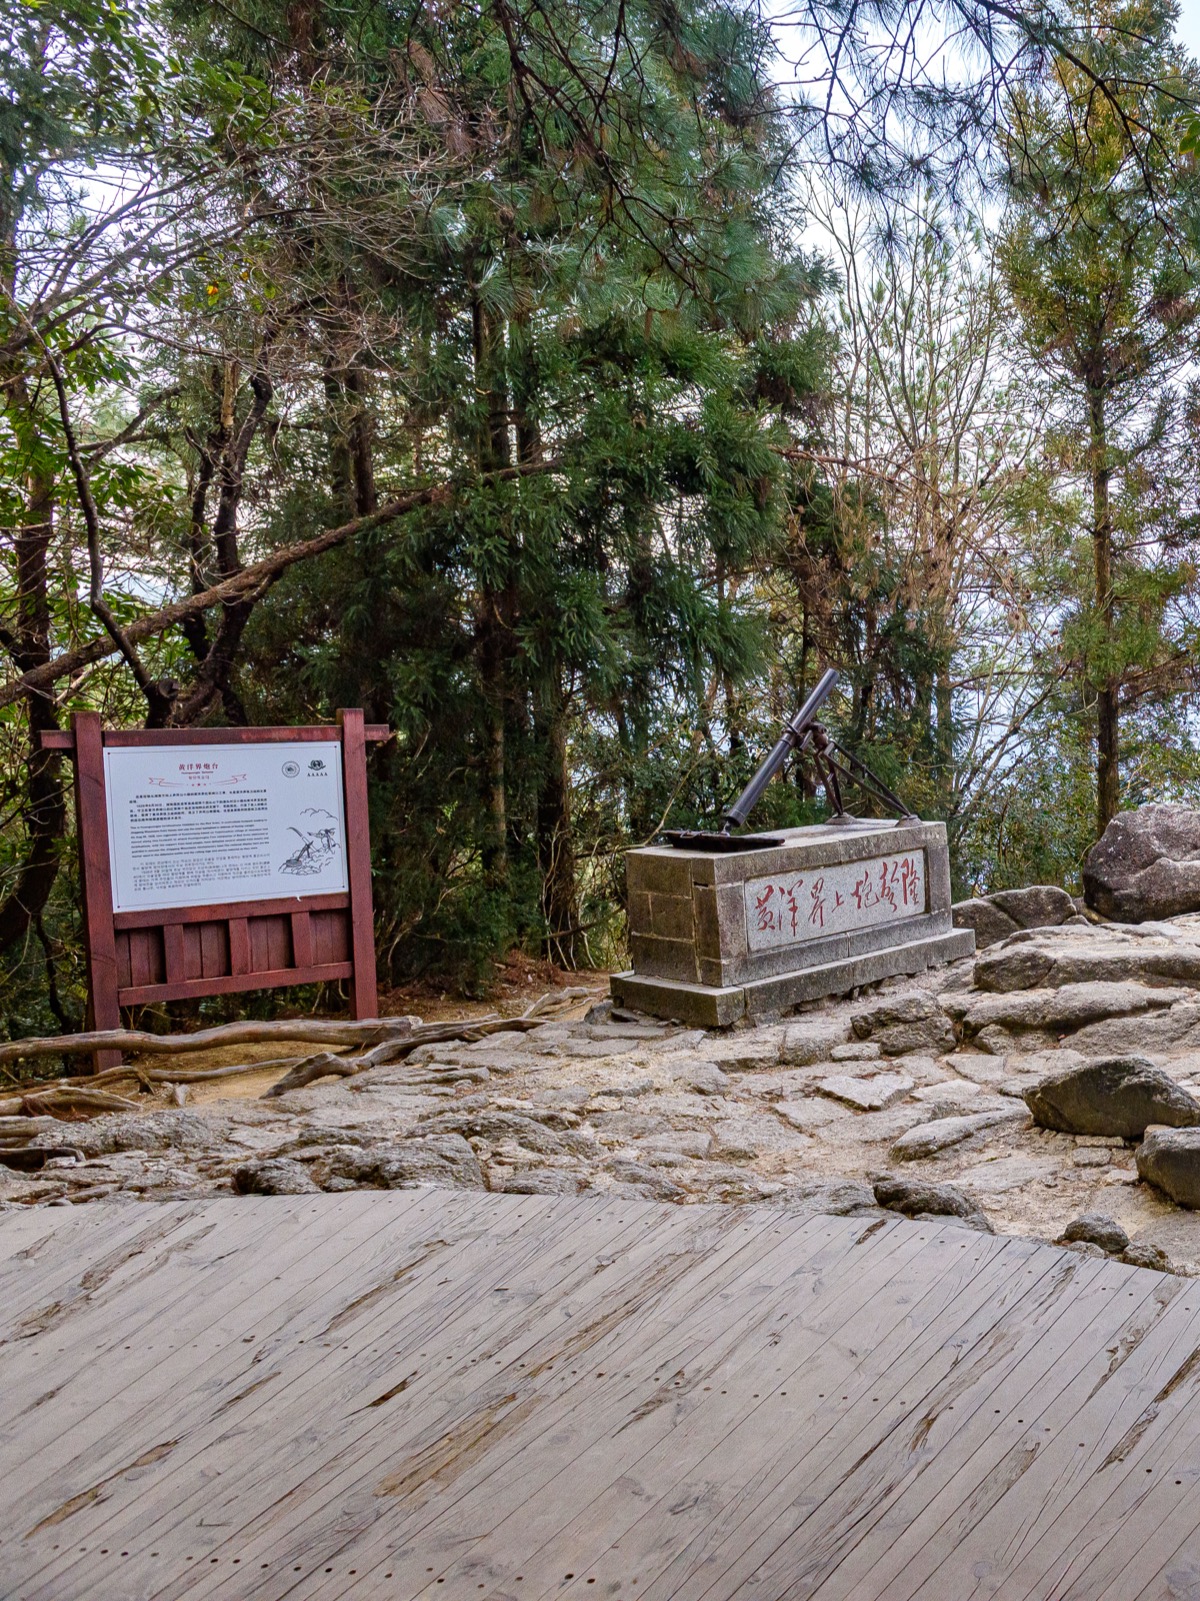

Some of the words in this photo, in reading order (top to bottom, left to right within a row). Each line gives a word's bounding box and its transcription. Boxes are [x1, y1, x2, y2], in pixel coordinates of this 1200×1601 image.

[179, 763, 218, 771] 黄洋界炮台
